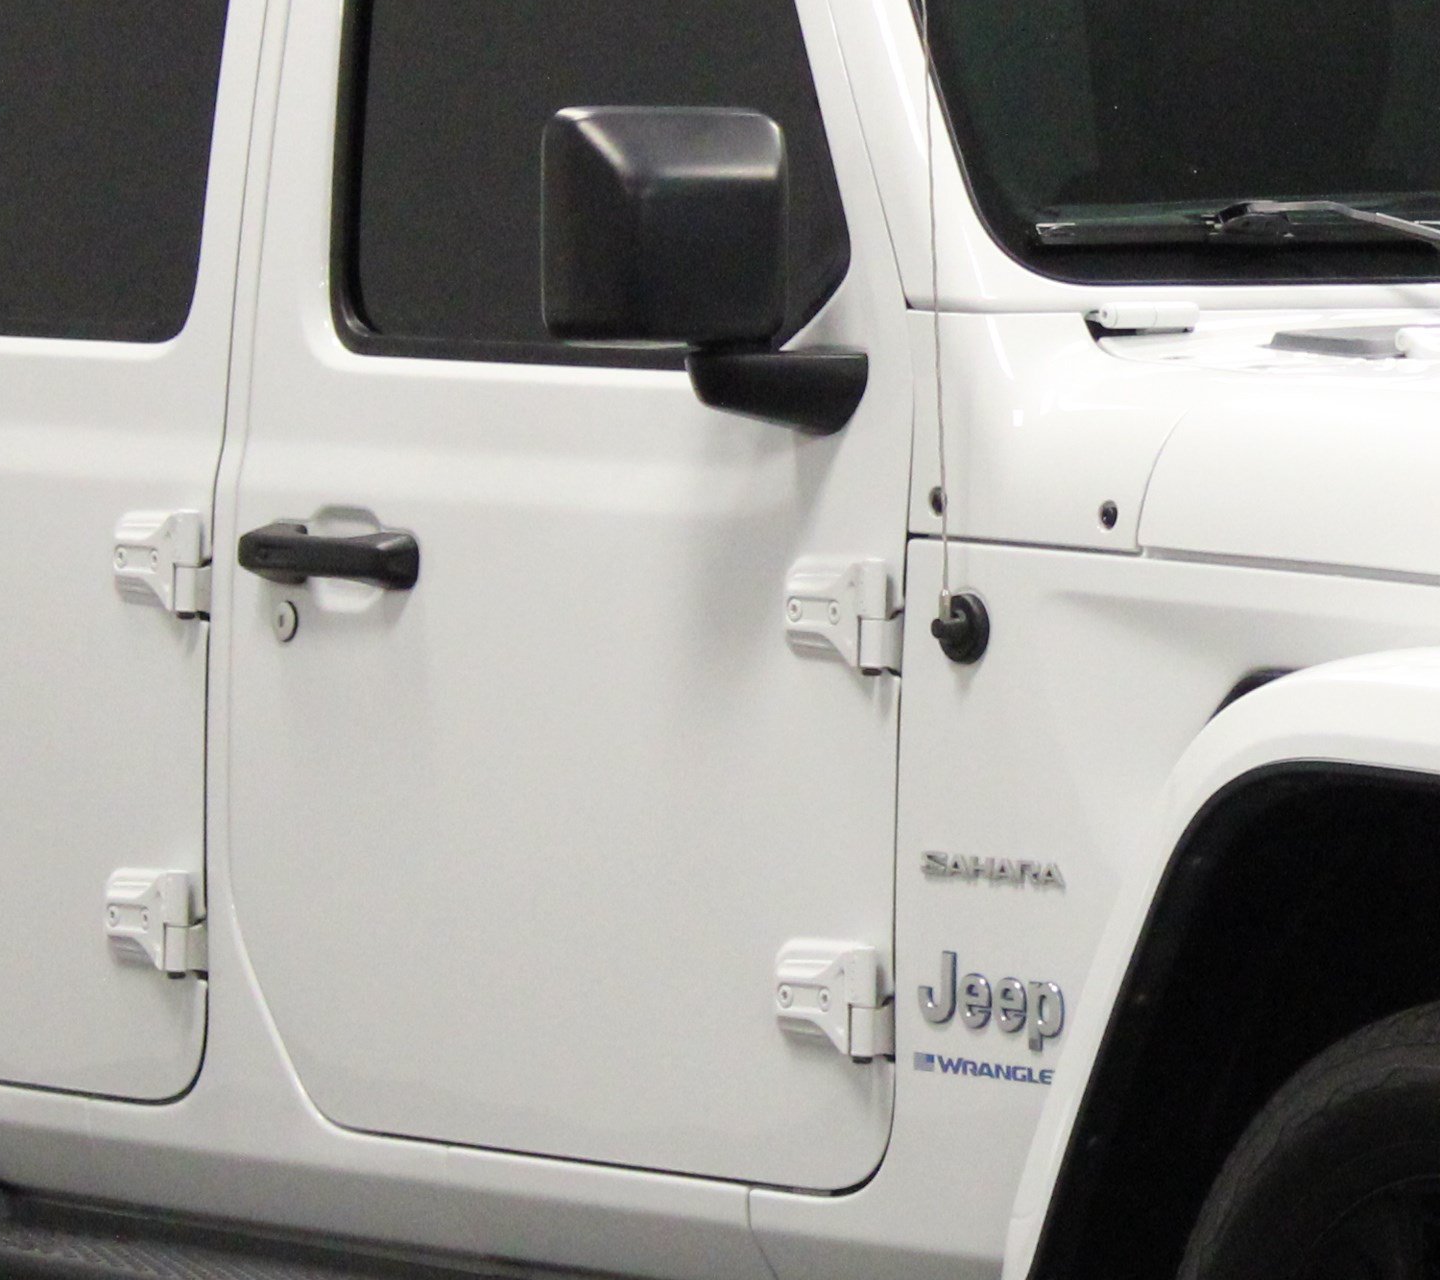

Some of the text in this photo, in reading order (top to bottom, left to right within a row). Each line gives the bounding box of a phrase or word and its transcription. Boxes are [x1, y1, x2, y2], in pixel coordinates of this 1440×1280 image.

[920, 849, 1066, 890] SAHARA
[917, 949, 1066, 1053] Jeep
[937, 1054, 1055, 1085] WRANGLE
